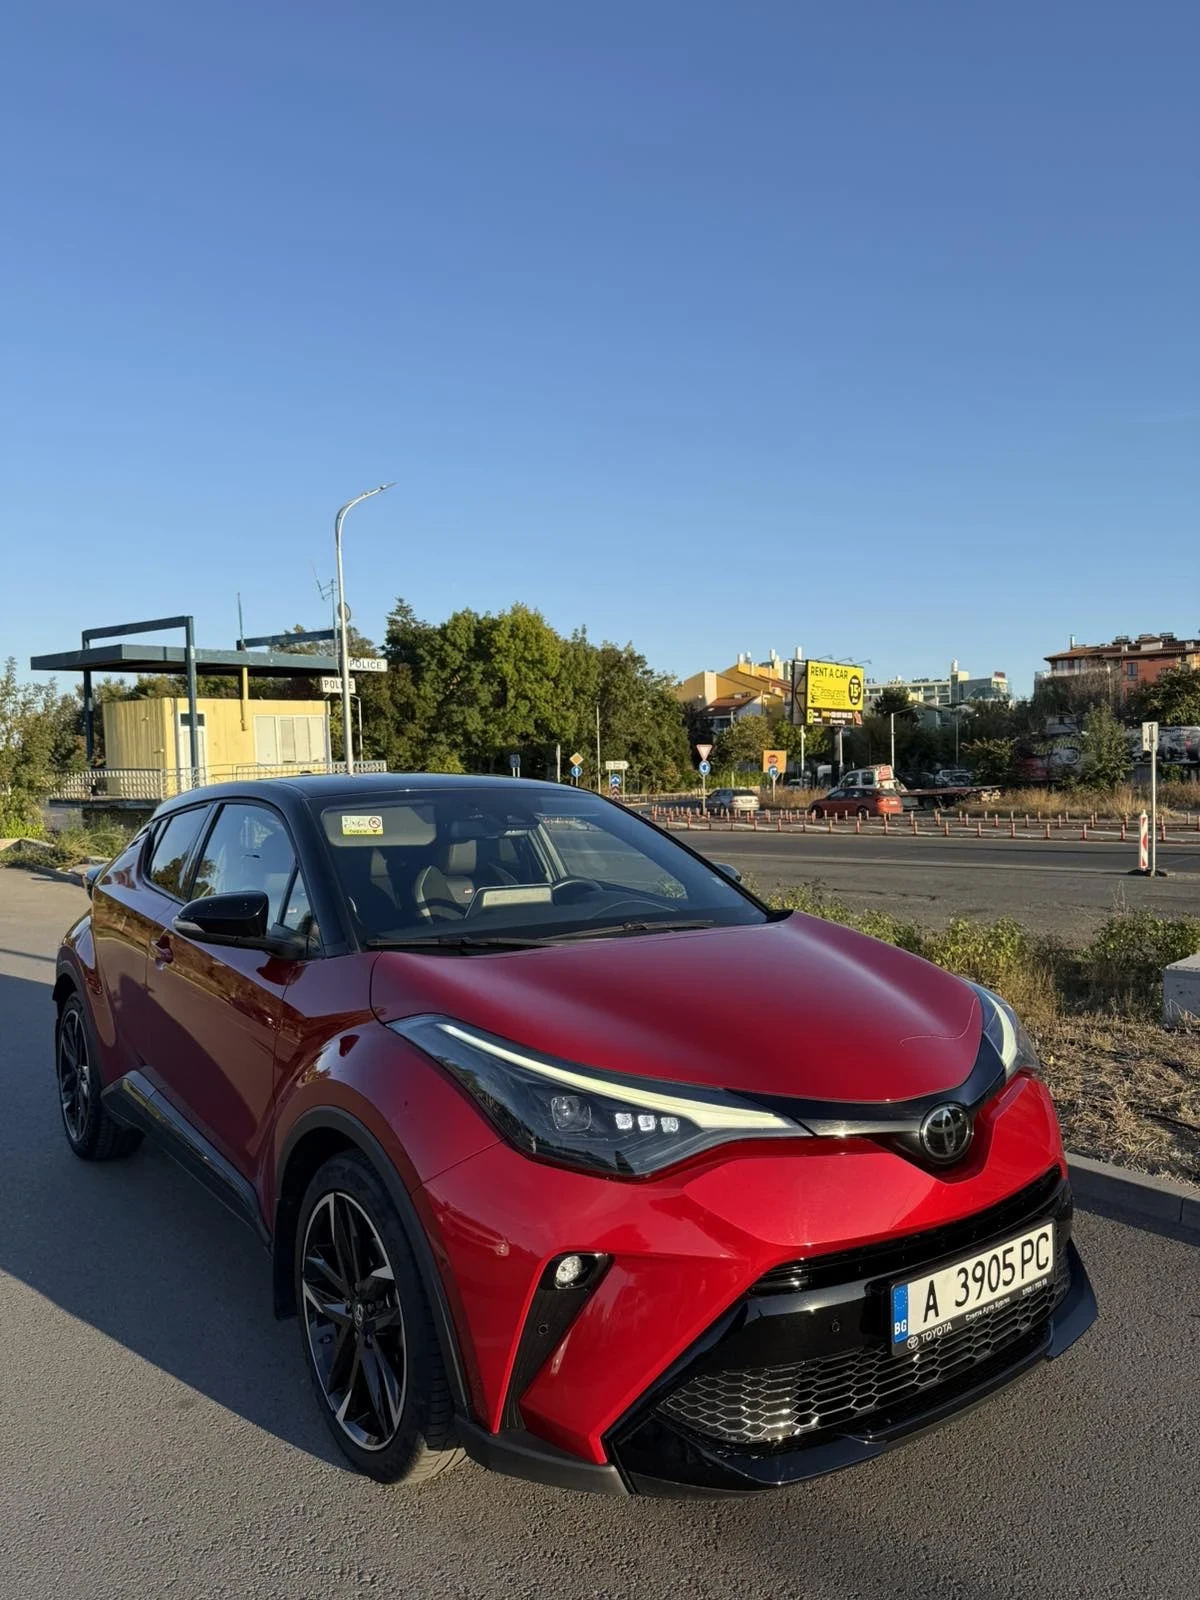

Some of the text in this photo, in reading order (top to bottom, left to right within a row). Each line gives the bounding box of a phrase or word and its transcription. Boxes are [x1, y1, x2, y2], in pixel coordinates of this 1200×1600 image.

[349, 659, 382, 670] POLICE
[810, 665, 849, 680] RENT A CAR
[323, 679, 354, 690] POLE
[922, 1232, 1049, 1323] A 3905 PC
[894, 1319, 907, 1336] BG
[920, 1322, 953, 1343] TOYOTA
